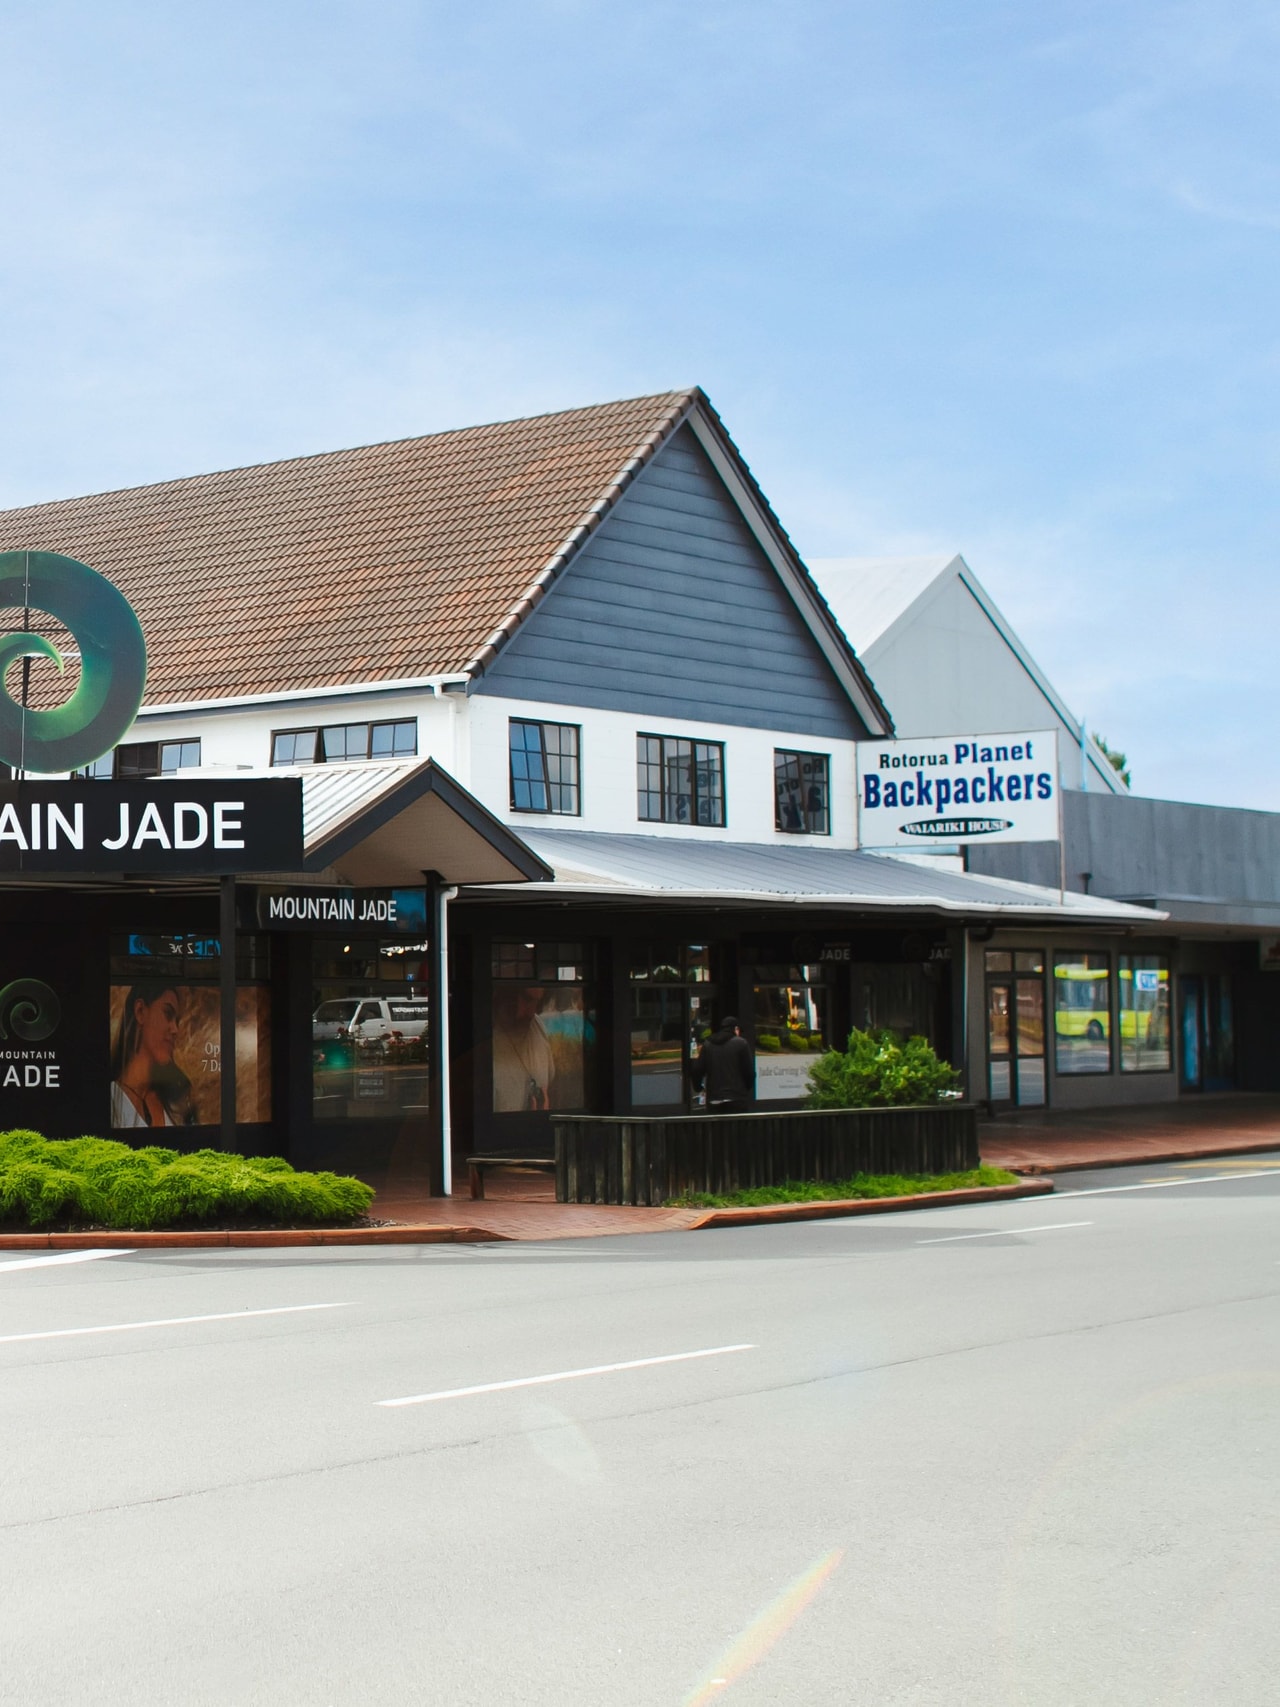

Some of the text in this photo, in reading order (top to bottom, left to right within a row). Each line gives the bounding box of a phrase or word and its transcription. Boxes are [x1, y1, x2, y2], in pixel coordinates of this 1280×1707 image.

[879, 741, 1033, 769] Rotorua Planet
[863, 767, 1052, 814] Backpackers
[101, 802, 245, 849] JADE
[269, 897, 397, 921] MOUNTAIN JADE
[205, 1042, 221, 1057] Op
[202, 1060, 208, 1072] 7
